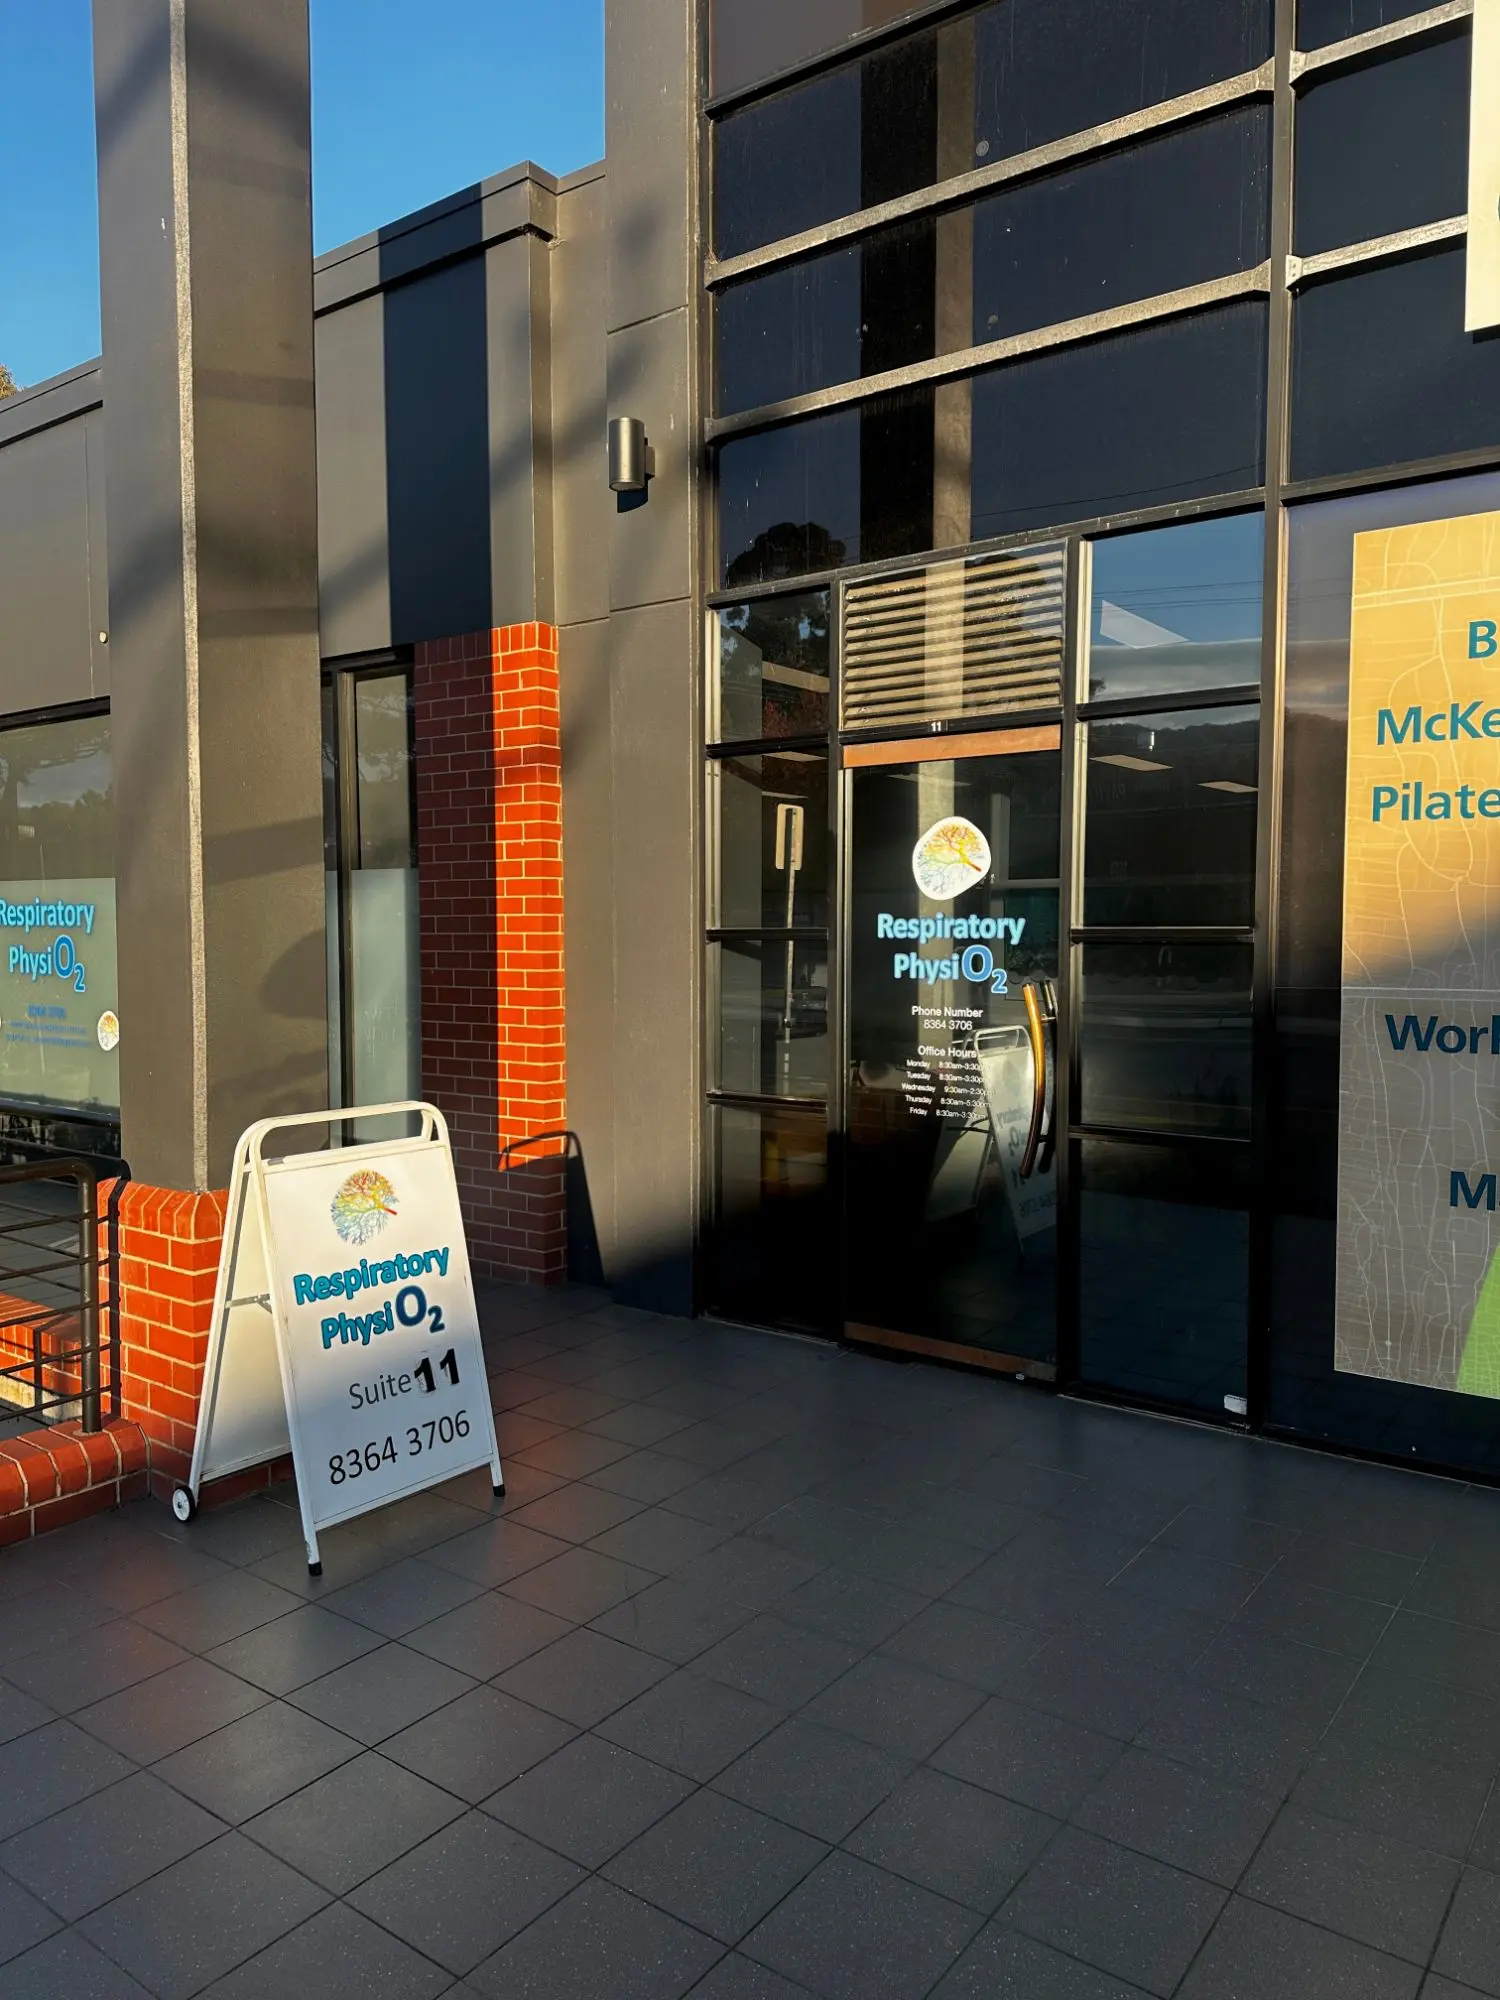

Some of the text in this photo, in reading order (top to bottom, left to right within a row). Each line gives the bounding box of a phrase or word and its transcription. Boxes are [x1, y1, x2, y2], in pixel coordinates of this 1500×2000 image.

[930, 720, 942, 732] 11
[876, 911, 1026, 945] Respiratory
[911, 1005, 984, 1018] Phone Number
[923, 1019, 973, 1031] 8364 3706
[917, 1045, 977, 1059] Office Hours
[906, 1059, 931, 1070] Monday
[906, 1071, 932, 1081] Tuesday
[901, 1082, 937, 1093] Wednesday
[905, 1094, 933, 1105] Thursday
[909, 1106, 929, 1117] Friday
[1450, 1170, 1500, 1212] M
[293, 1246, 450, 1306] Respiratory
[349, 1348, 460, 1410] Suite 11
[329, 1409, 470, 1485] 8364 3706
